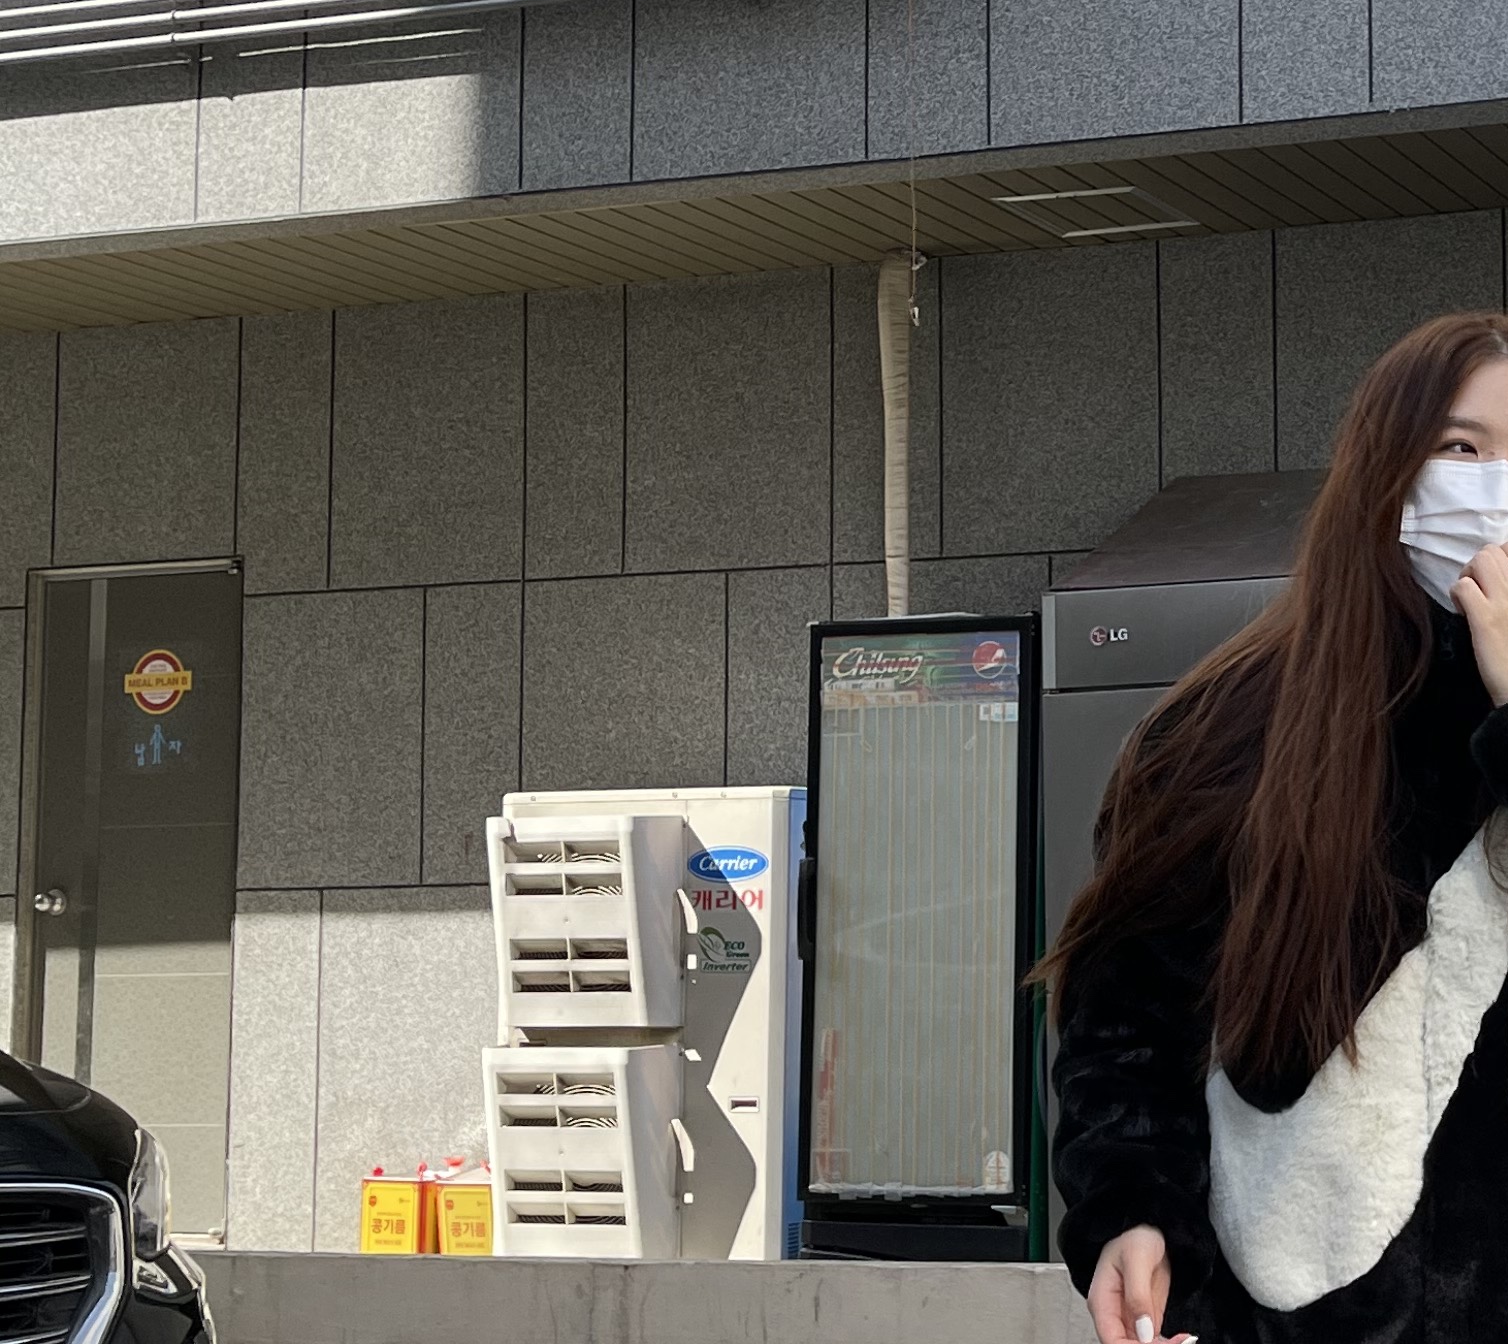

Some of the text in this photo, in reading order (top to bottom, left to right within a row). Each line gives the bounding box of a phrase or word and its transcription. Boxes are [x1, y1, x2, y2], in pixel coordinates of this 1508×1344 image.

[1110, 628, 1128, 641] LG
[832, 647, 924, 684] Chilsung
[128, 675, 188, 688] MEAL PLAN B
[700, 855, 758, 871] Carrier
[691, 889, 765, 911] 캐리어
[724, 941, 745, 951] ECO
[371, 1218, 406, 1235] 콩기름
[450, 1221, 486, 1238] 콩기름
